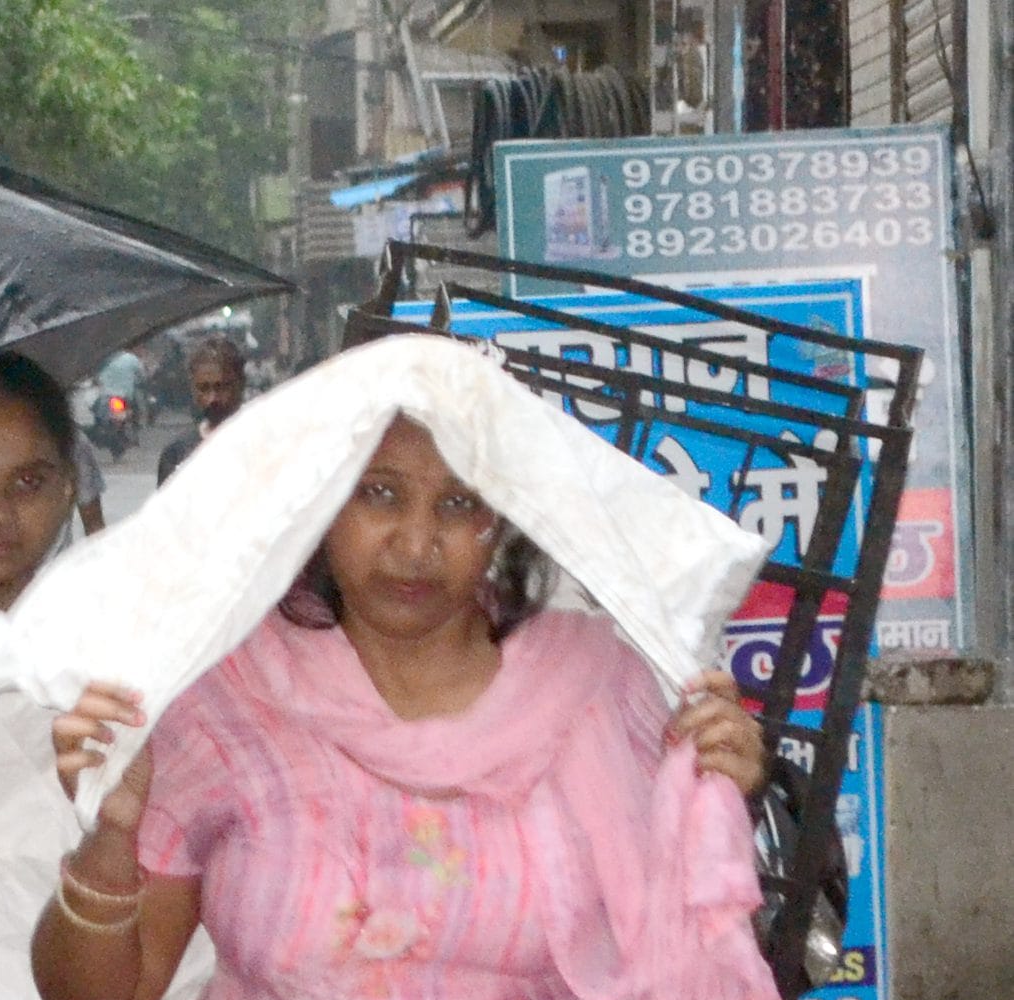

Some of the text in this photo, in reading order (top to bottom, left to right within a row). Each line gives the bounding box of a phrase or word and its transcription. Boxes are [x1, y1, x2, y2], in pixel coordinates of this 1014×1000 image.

[621, 146, 931, 189] 9760378939
[624, 181, 932, 224] 9781883733
[626, 217, 934, 258] 8923026403
